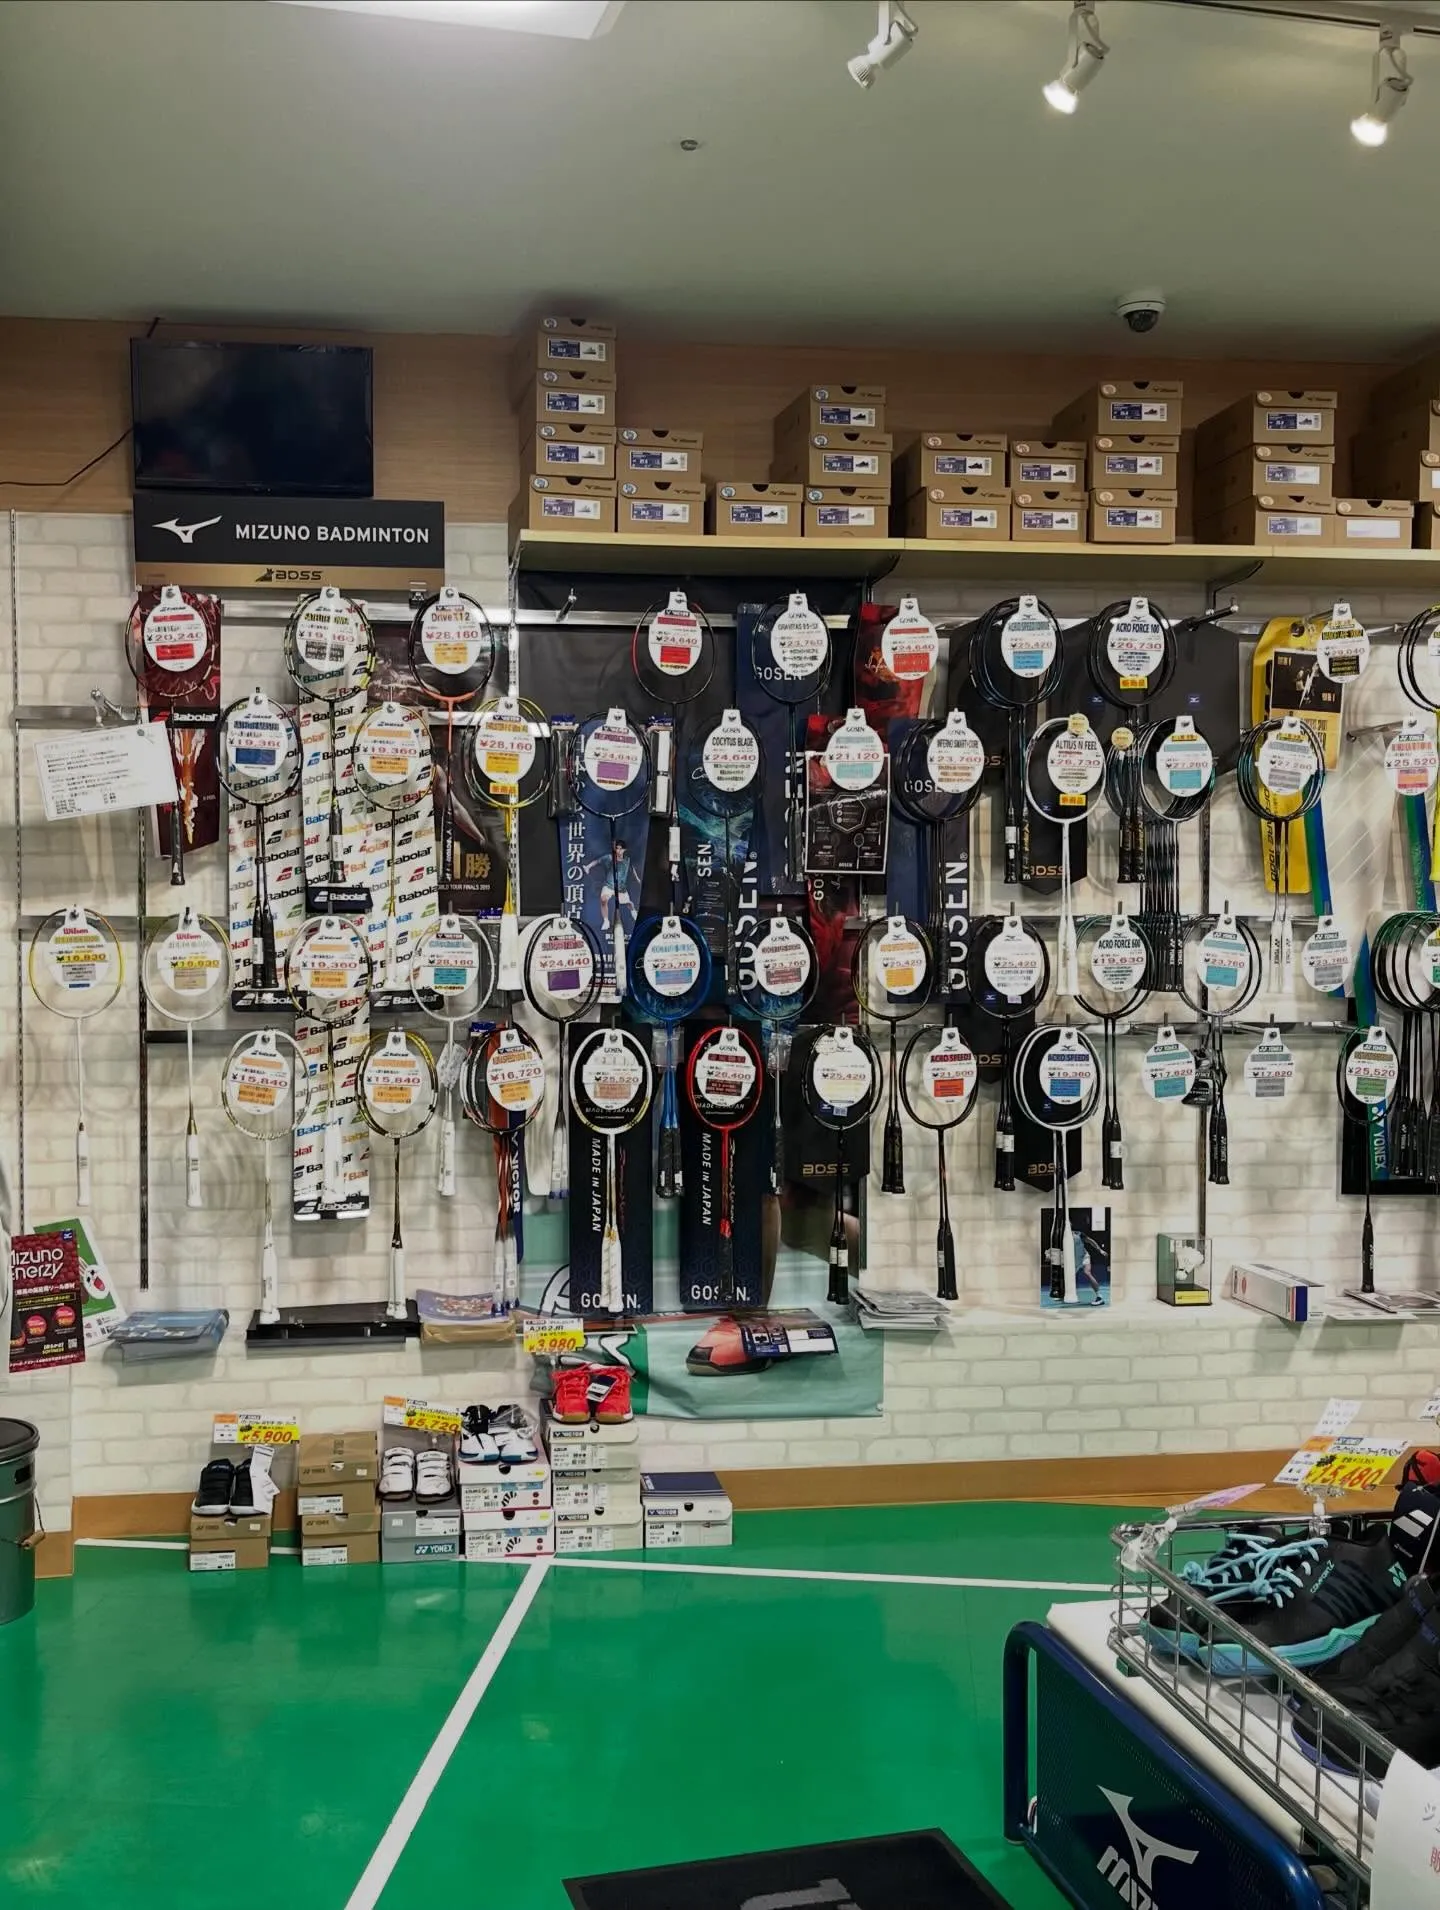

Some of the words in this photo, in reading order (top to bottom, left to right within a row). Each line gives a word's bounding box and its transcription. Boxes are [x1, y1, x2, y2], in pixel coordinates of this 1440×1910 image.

[235, 524, 310, 541] MIZUNO
[316, 526, 430, 544] BADMINTON
[1115, 623, 1131, 634] ACRO
[1132, 623, 1149, 634] FORCE
[425, 631, 480, 641] ¥28,160
[1109, 641, 1162, 650] ¥26,730
[480, 740, 532, 751] ¥28,160
[712, 736, 736, 747] COCYTUS
[738, 736, 754, 747] BLADE
[1055, 740, 1075, 750] ALTIUS
[1084, 740, 1097, 750] FEEL
[363, 746, 417, 756] ¥19,360
[828, 752, 880, 761] ¥21,120
[704, 753, 756, 762] ¥24,640
[1386, 757, 1437, 768] ¥25,520
[375, 811, 420, 832] Babolat
[63, 927, 88, 935] Wilson
[946, 861, 969, 991] GOSEN
[1098, 939, 1113, 949] ACRO
[1114, 938, 1131, 949] FORCE
[302, 960, 358, 969] ¥19,360
[539, 957, 590, 968] ¥24,640
[1093, 956, 1144, 965] ¥19,630
[490, 1067, 542, 1081] ¥16,720
[1348, 1066, 1395, 1077] ¥25,520
[232, 1072, 288, 1087] ¥15,840
[366, 1076, 421, 1084] ¥15,840
[592, 1137, 602, 1174] MADE
[702, 1132, 712, 1169] MADE
[1373, 1131, 1387, 1169] YONEX
[702, 1184, 712, 1226] JAPAN
[592, 1190, 602, 1233] JAPAN
[529, 1337, 577, 1352] ¥3,980
[408, 1417, 459, 1433] ¥5,720
[242, 1430, 292, 1443] ¥5,800
[430, 1545, 454, 1554] YONEX
